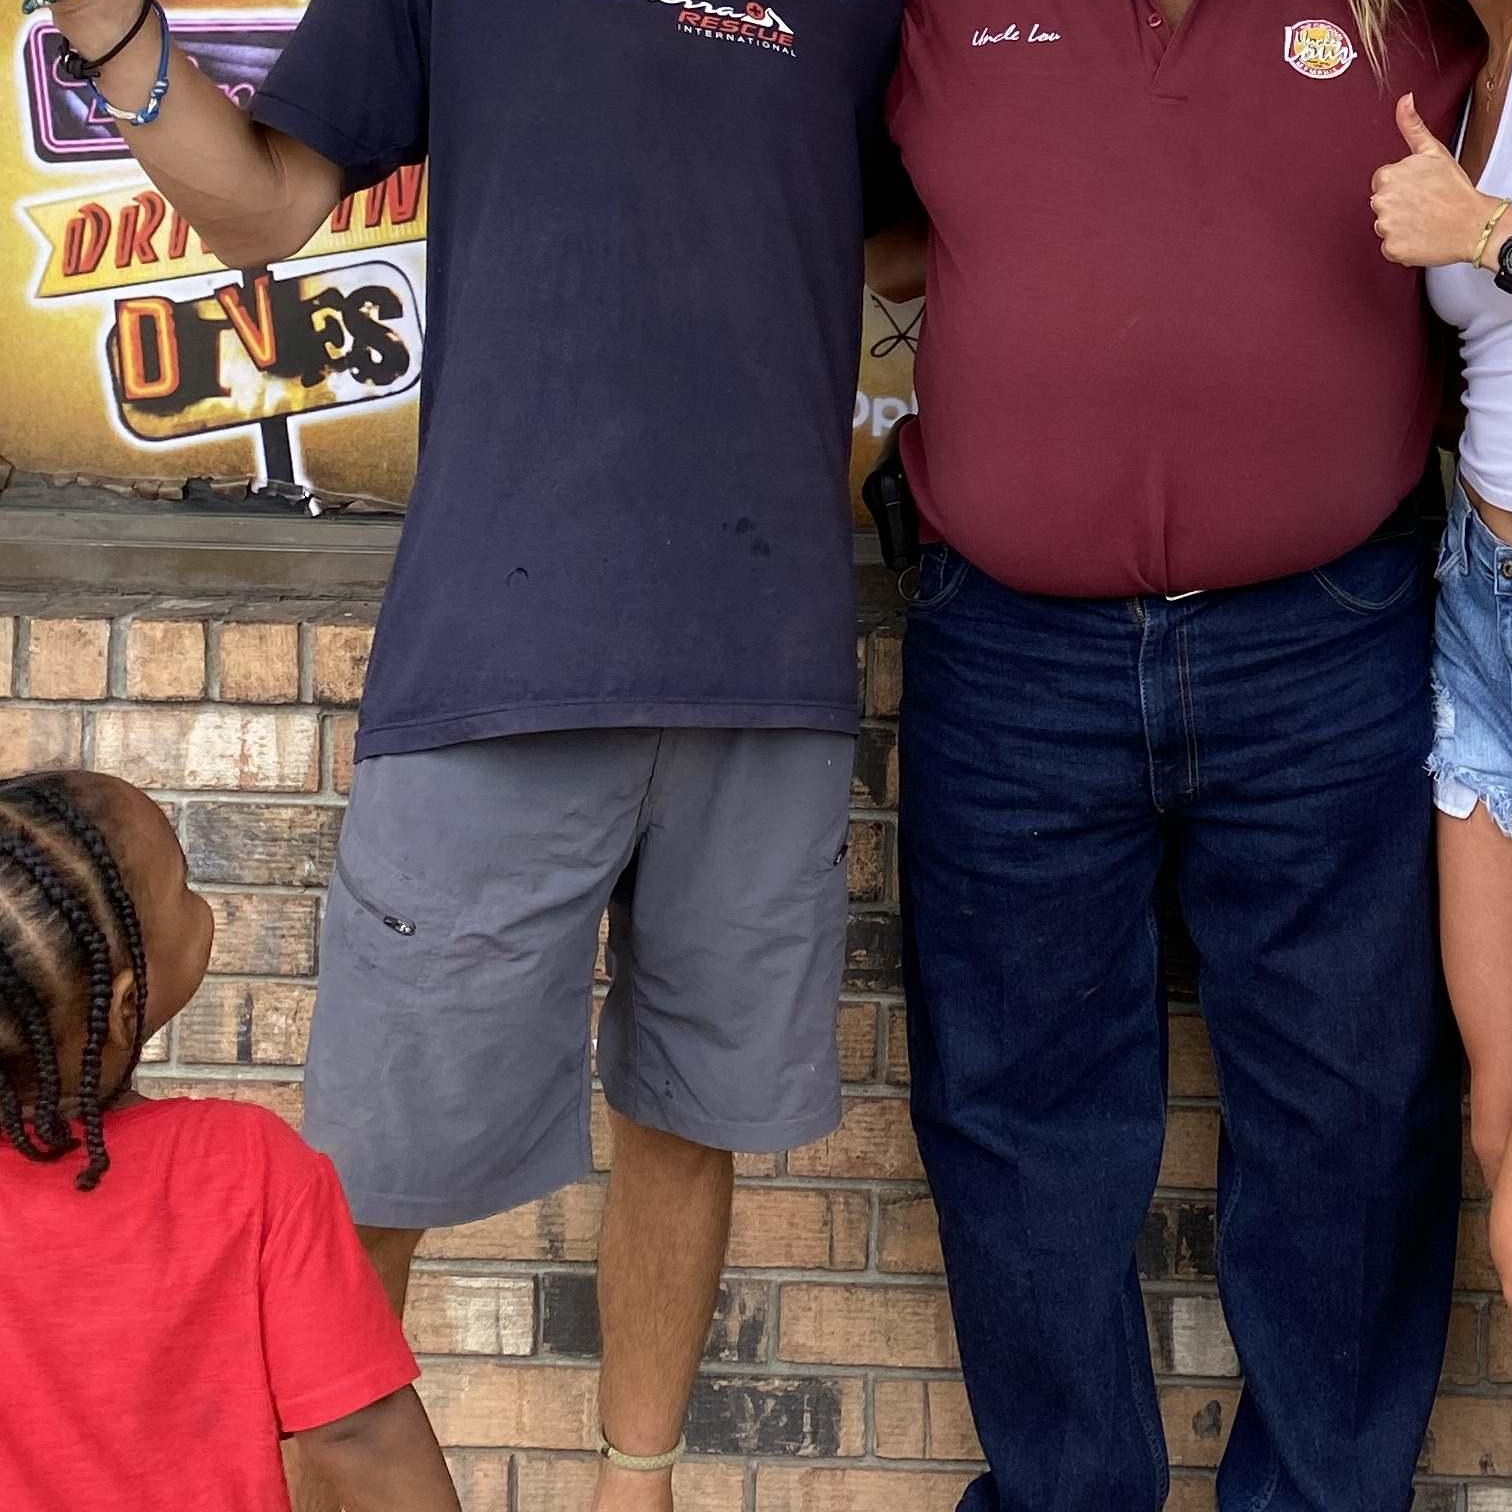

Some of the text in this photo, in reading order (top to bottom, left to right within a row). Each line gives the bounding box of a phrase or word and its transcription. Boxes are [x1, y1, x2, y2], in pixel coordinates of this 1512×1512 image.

[677, 8, 793, 47] RESCUE
[677, 23, 797, 58] INTERNATIONAL
[971, 23, 1061, 46] Uncle Lou
